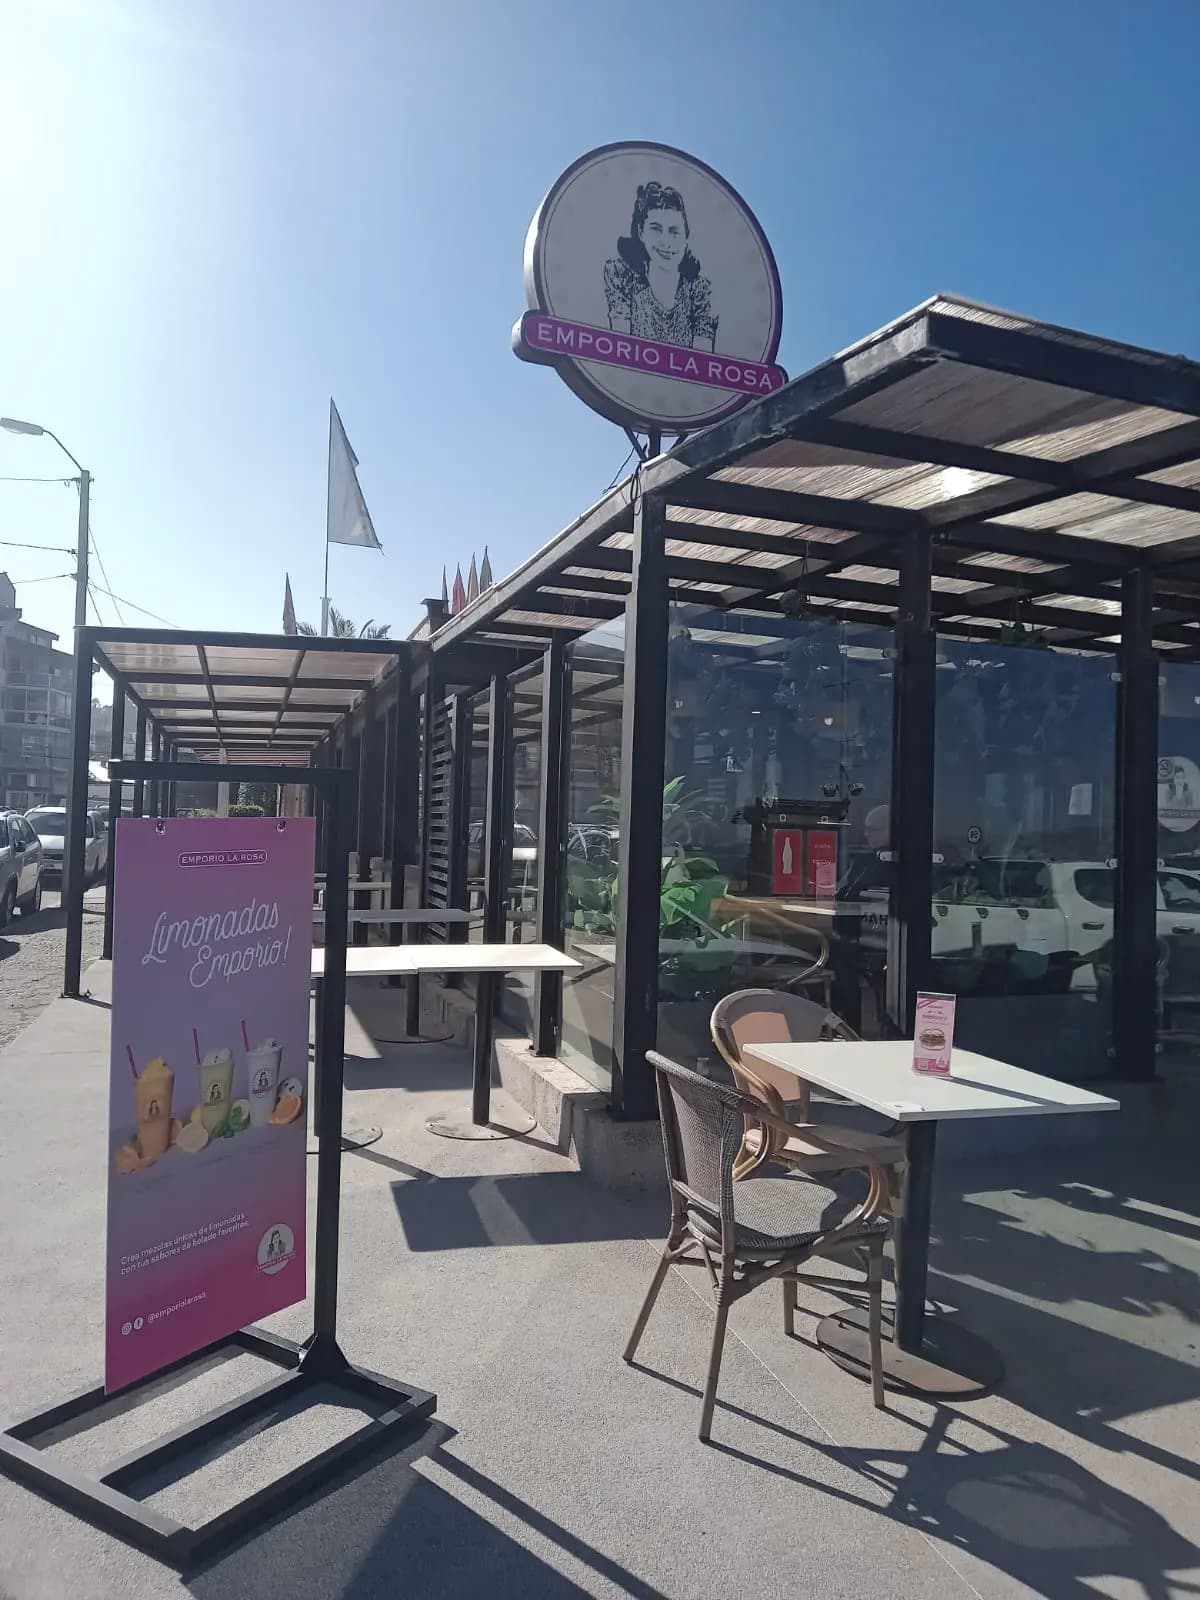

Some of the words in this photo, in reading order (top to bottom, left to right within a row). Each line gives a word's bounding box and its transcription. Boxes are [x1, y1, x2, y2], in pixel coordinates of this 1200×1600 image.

[537, 323, 659, 366] EMPORIO
[669, 355, 699, 375] LA
[707, 362, 773, 390] ROSA
[181, 854, 225, 864] EMPORIO
[227, 854, 238, 862] LA
[240, 853, 264, 861] ROSA
[141, 898, 279, 965] Limonadas
[189, 926, 292, 988] Emporio!
[120, 1263, 136, 1276] con
